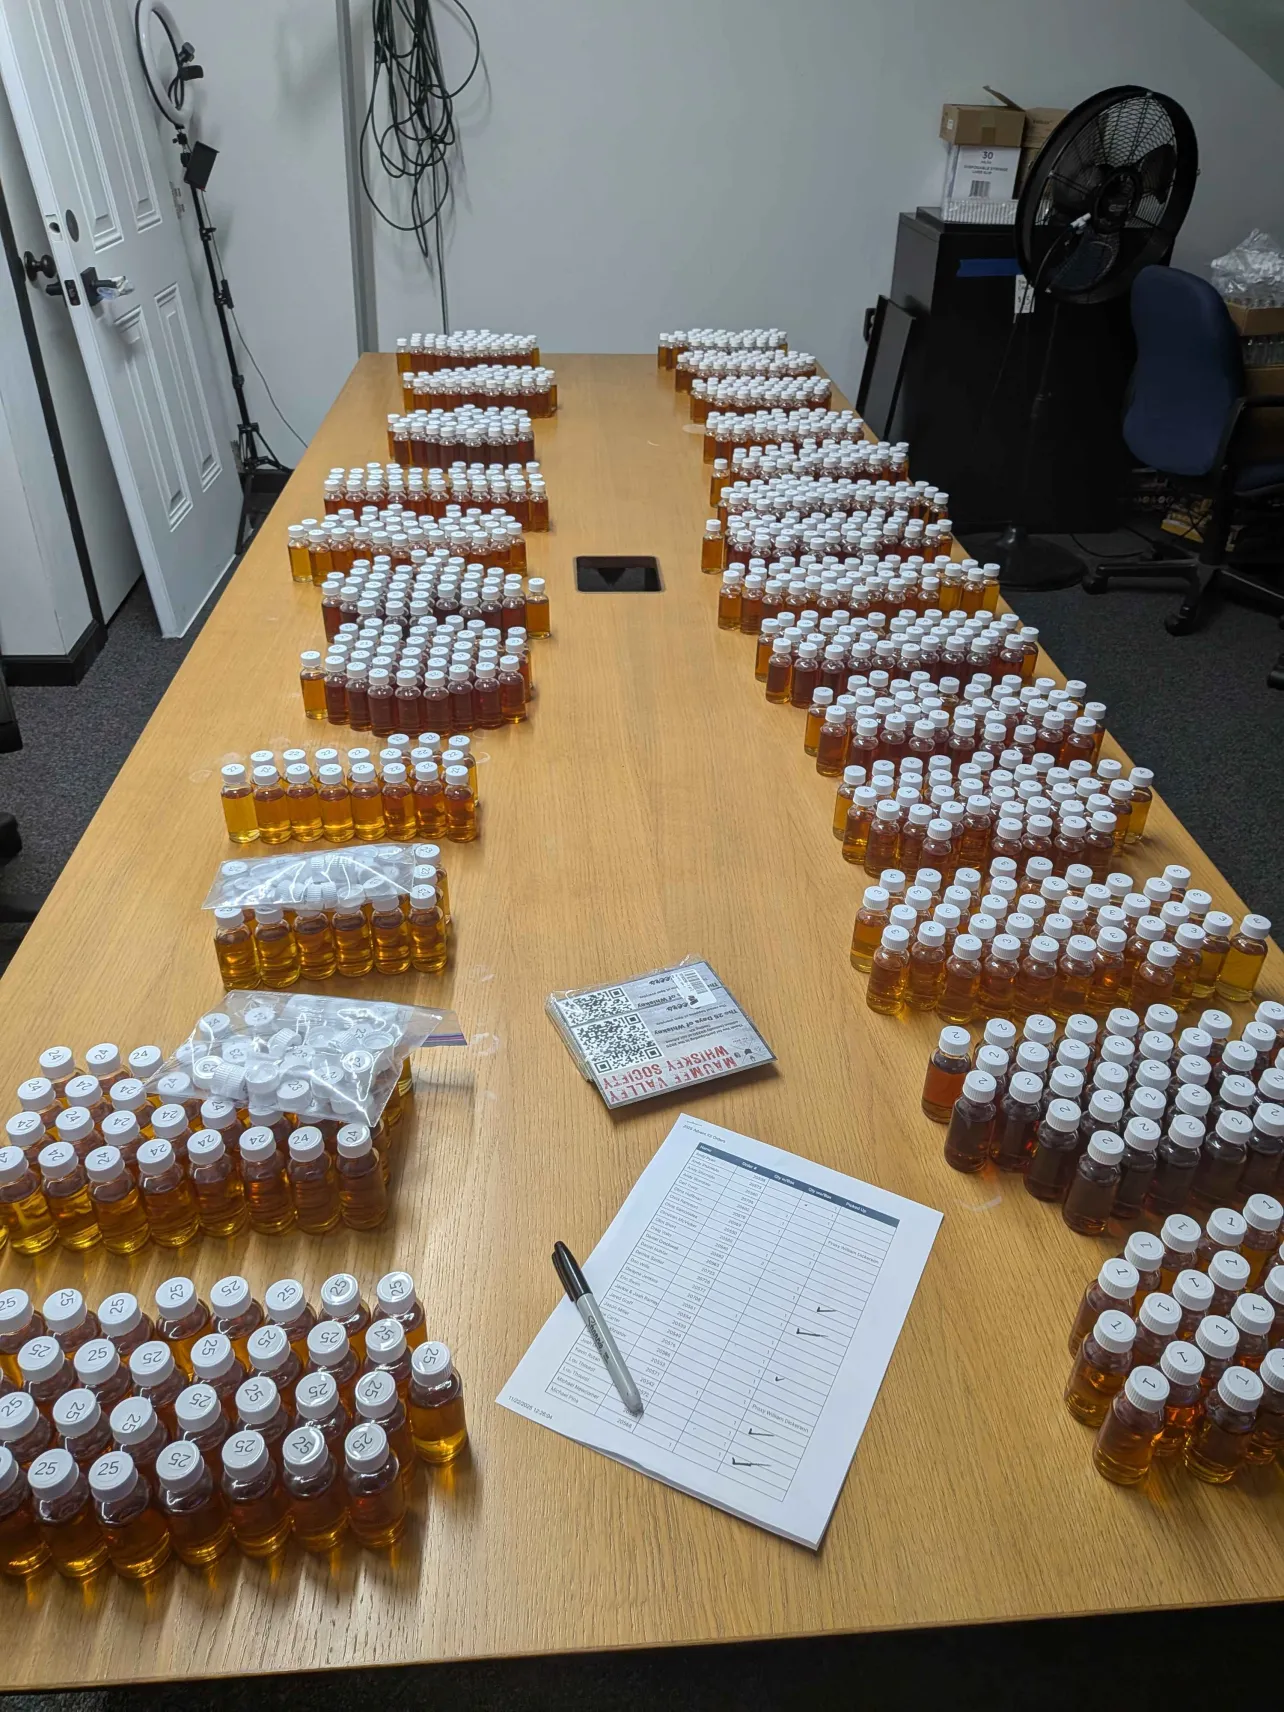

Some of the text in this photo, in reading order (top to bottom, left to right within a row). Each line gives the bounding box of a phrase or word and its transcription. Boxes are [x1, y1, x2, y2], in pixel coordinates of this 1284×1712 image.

[982, 151, 994, 159] 30
[693, 1015, 713, 1024] Days
[1213, 1013, 1221, 1022] 2
[652, 1023, 685, 1035] Whiskey
[997, 1023, 1008, 1031] 2
[689, 1031, 716, 1040] participating
[952, 1031, 960, 1039] 2
[1153, 1035, 1163, 1044] 2
[1238, 1045, 1250, 1053] 2
[48, 1050, 64, 1061] 24
[94, 1050, 108, 1060] 24
[132, 1050, 148, 1060] 24
[988, 1051, 1000, 1059] 2
[600, 1045, 729, 1089] WHISKEY SOCIETY
[1110, 1067, 1120, 1076] 2
[606, 1056, 738, 1102] MAUMEE VALLEY
[1024, 1077, 1033, 1086] 2
[28, 1080, 42, 1091] 24
[76, 1080, 92, 1090] 24
[1145, 1092, 1157, 1101] 2
[113, 1118, 130, 1126] 24
[1231, 1117, 1243, 1125] 2
[198, 1134, 214, 1147] 24
[249, 1134, 267, 1145] 24
[291, 1133, 310, 1145] 24
[711, 1135, 726, 1143] Orders
[48, 1149, 64, 1161] 24
[150, 1144, 167, 1156] 24
[845, 1202, 860, 1210] Picked
[1262, 1200, 1274, 1210] 1
[1227, 1217, 1235, 1227] 1
[1116, 1268, 1129, 1276] 1
[330, 1278, 348, 1296] 25
[1188, 1277, 1200, 1288] 1
[170, 1284, 184, 1300] 25
[277, 1285, 296, 1302] 25
[60, 1290, 74, 1306] 25
[1252, 1304, 1265, 1312] 1
[605, 1314, 620, 1322] Carter
[1110, 1320, 1122, 1330] 1
[1215, 1324, 1229, 1335] 1
[374, 1326, 394, 1341] 25
[320, 1332, 340, 1347] 25
[202, 1340, 218, 1356] 25
[88, 1347, 107, 1362] 25
[555, 1375, 575, 1388] Michael
[1142, 1377, 1156, 1389] 1
[1235, 1374, 1250, 1386] 1
[244, 1384, 264, 1402] 25
[308, 1383, 328, 1398] 25
[548, 1385, 569, 1398] Michael
[66, 1402, 86, 1422] 25
[234, 1440, 256, 1452] 25
[352, 1431, 373, 1453] 25
[34, 1462, 58, 1475] 25
[98, 1461, 119, 1476] 25
